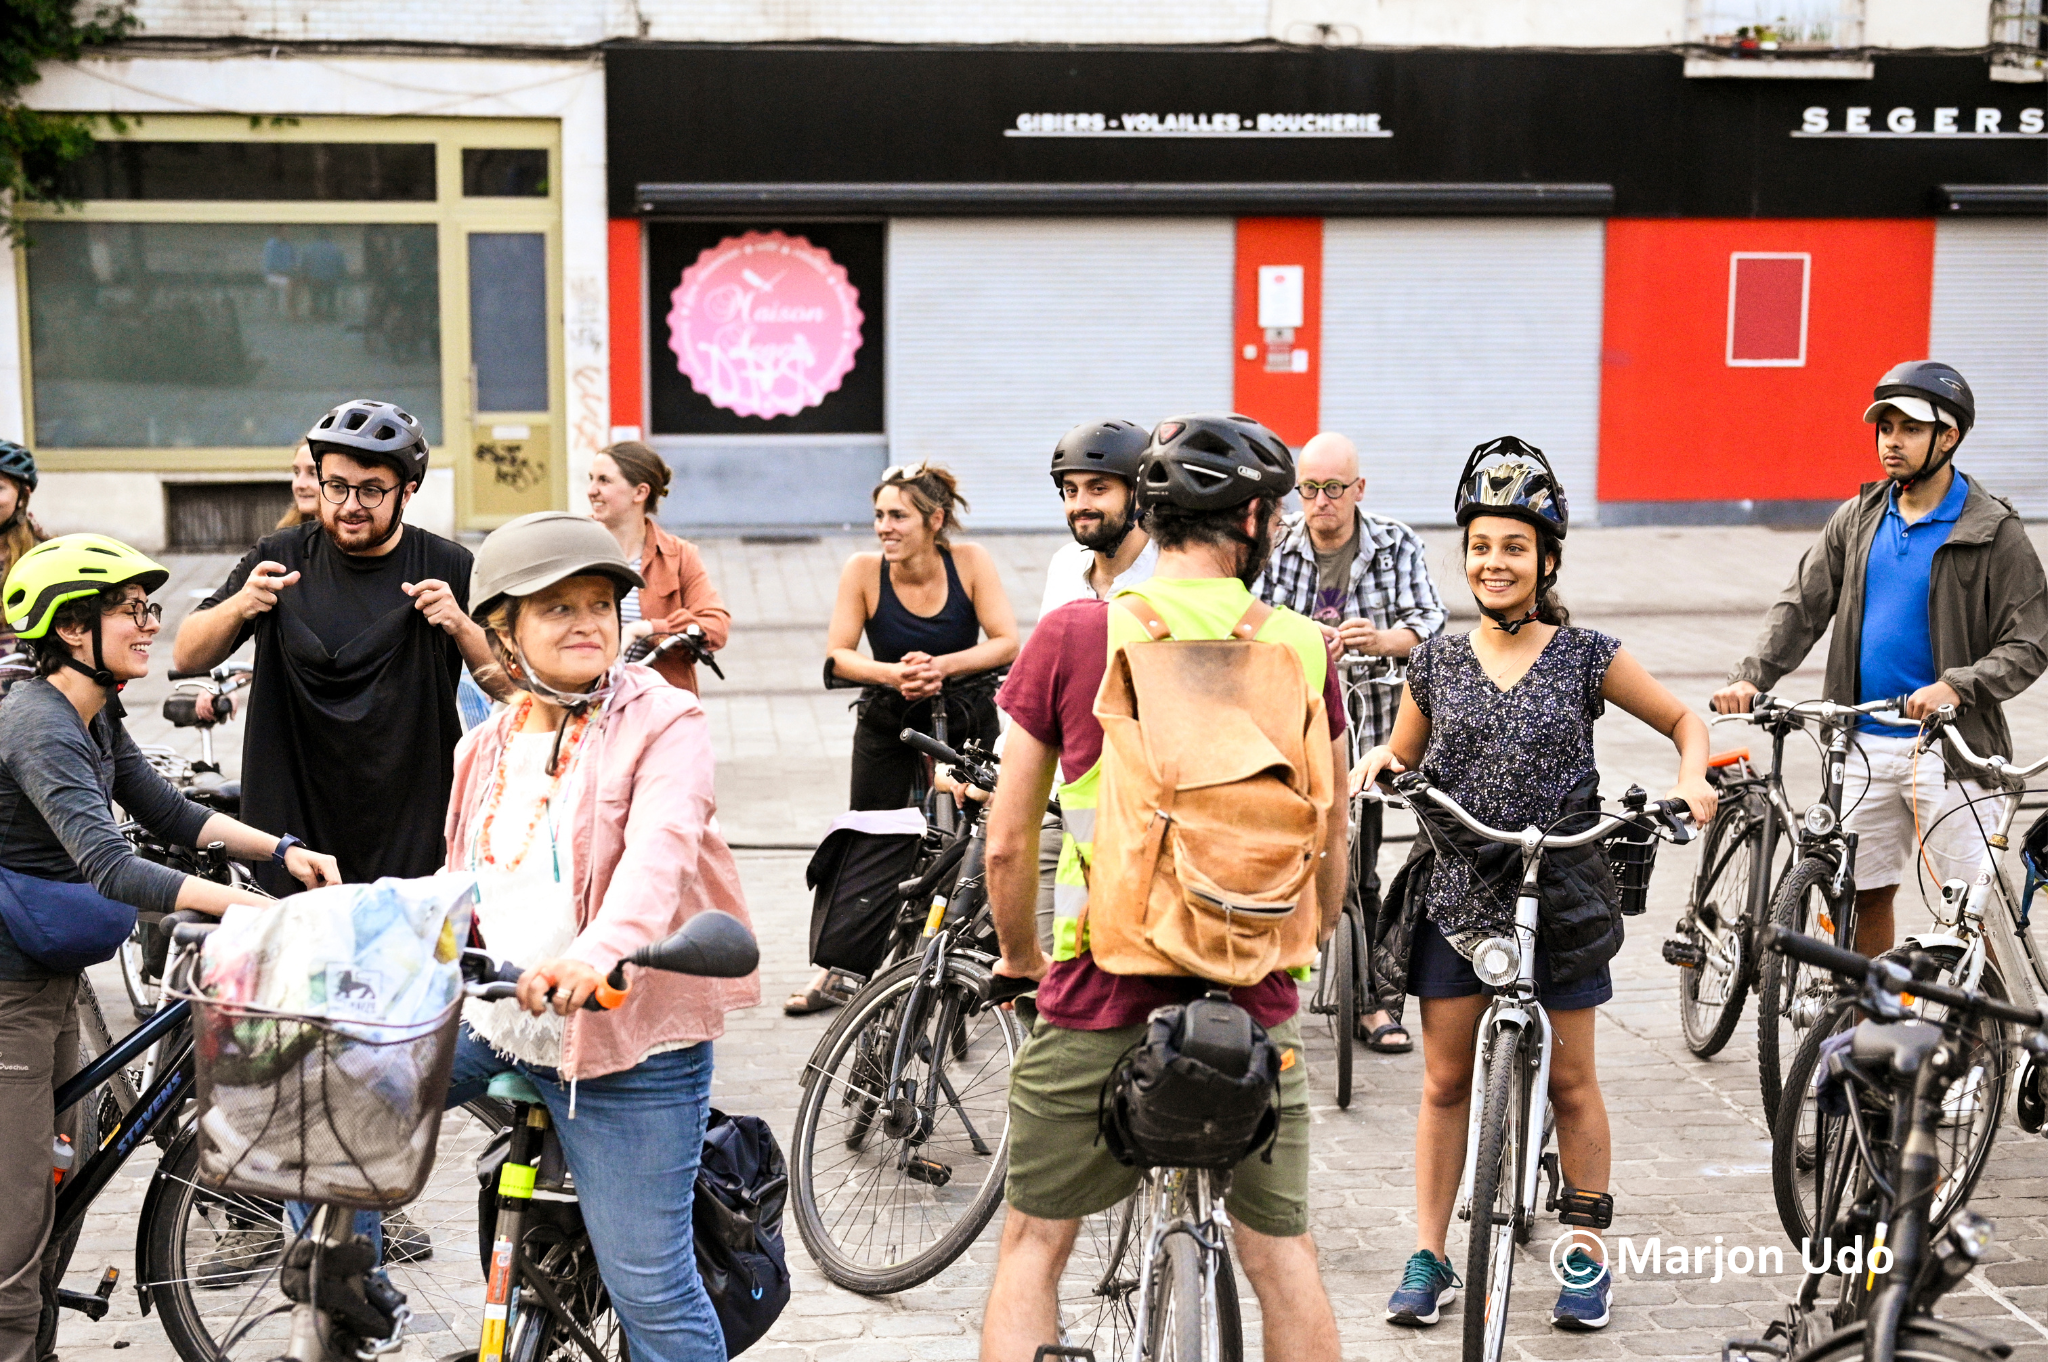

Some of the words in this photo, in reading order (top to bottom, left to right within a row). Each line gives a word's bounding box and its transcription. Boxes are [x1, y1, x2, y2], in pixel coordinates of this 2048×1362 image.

[1016, 113, 1106, 131] GIBIERS
[1122, 113, 1241, 131] VOLAILLES
[1257, 113, 1381, 131] BOUCHERIE
[1802, 106, 2045, 134] SEGERS
[117, 1070, 181, 1156] STEVENS
